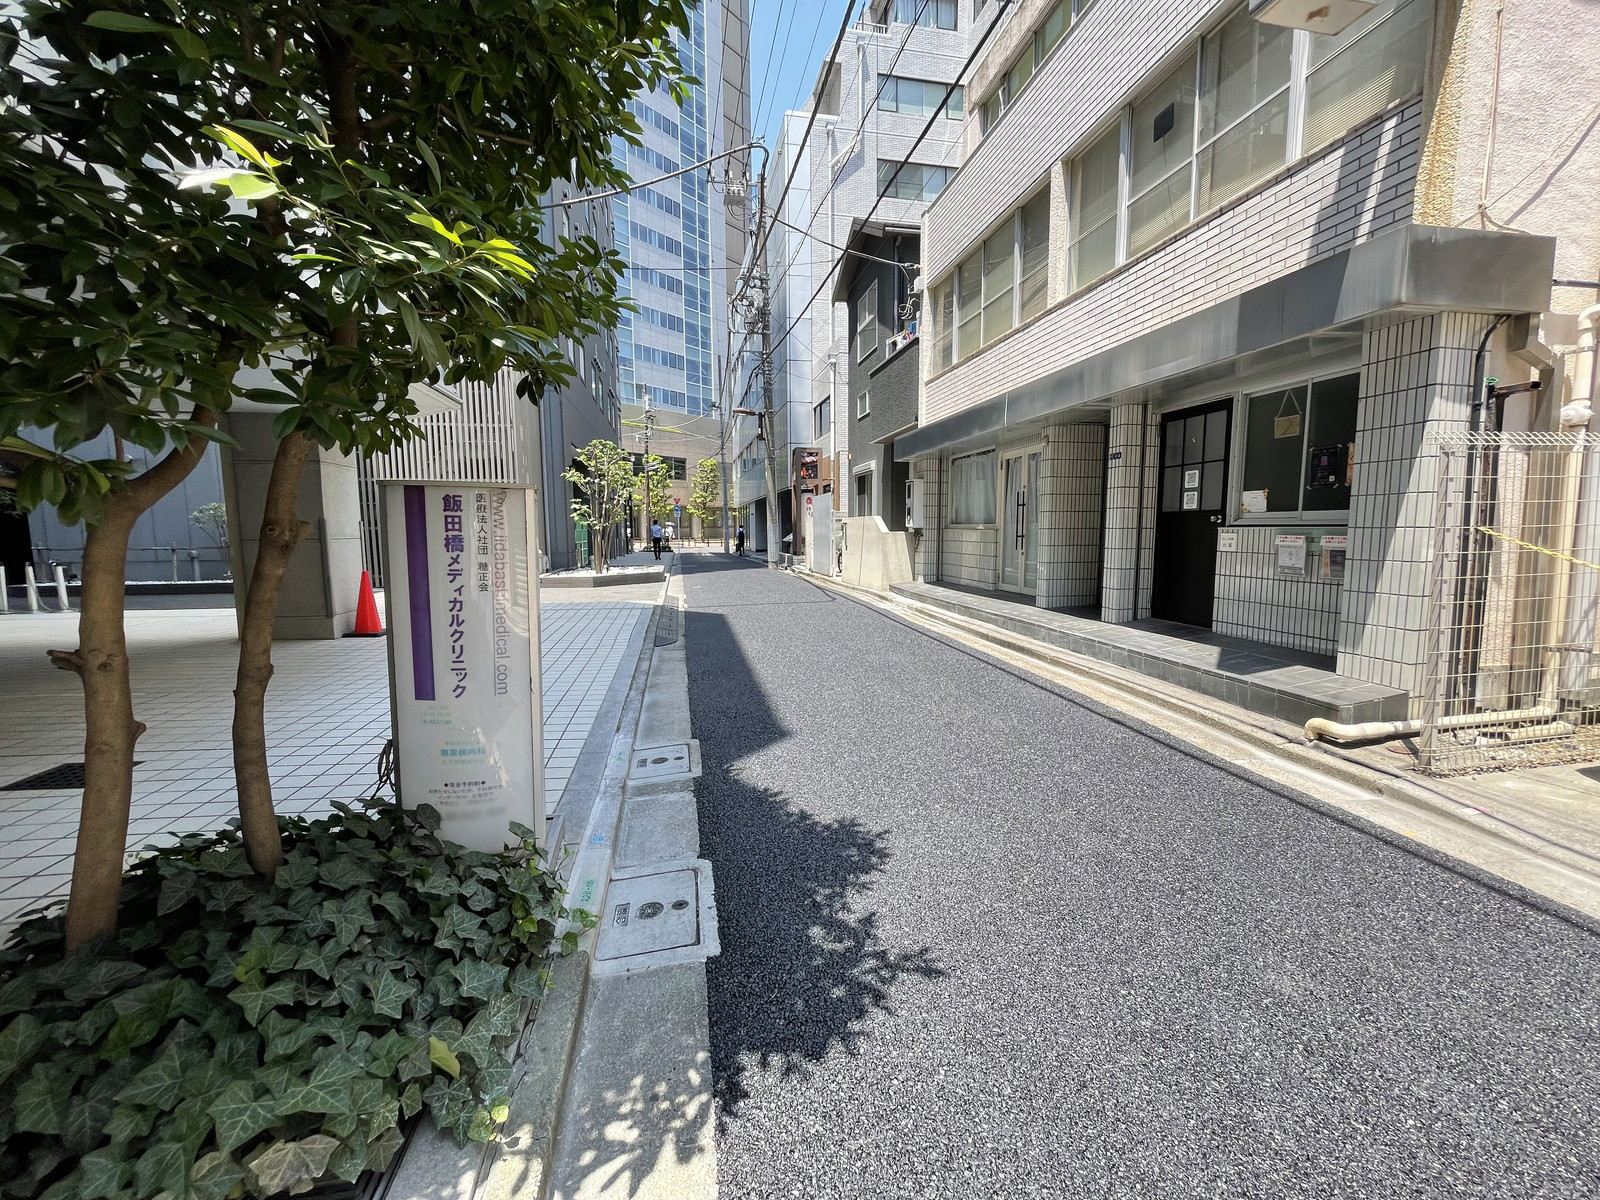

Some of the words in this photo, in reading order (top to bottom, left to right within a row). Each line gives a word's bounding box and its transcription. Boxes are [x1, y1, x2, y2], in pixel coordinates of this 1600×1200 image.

[475, 493, 489, 556] 医療法人社団
[442, 493, 467, 699] 飯田橋メディカルクリニック
